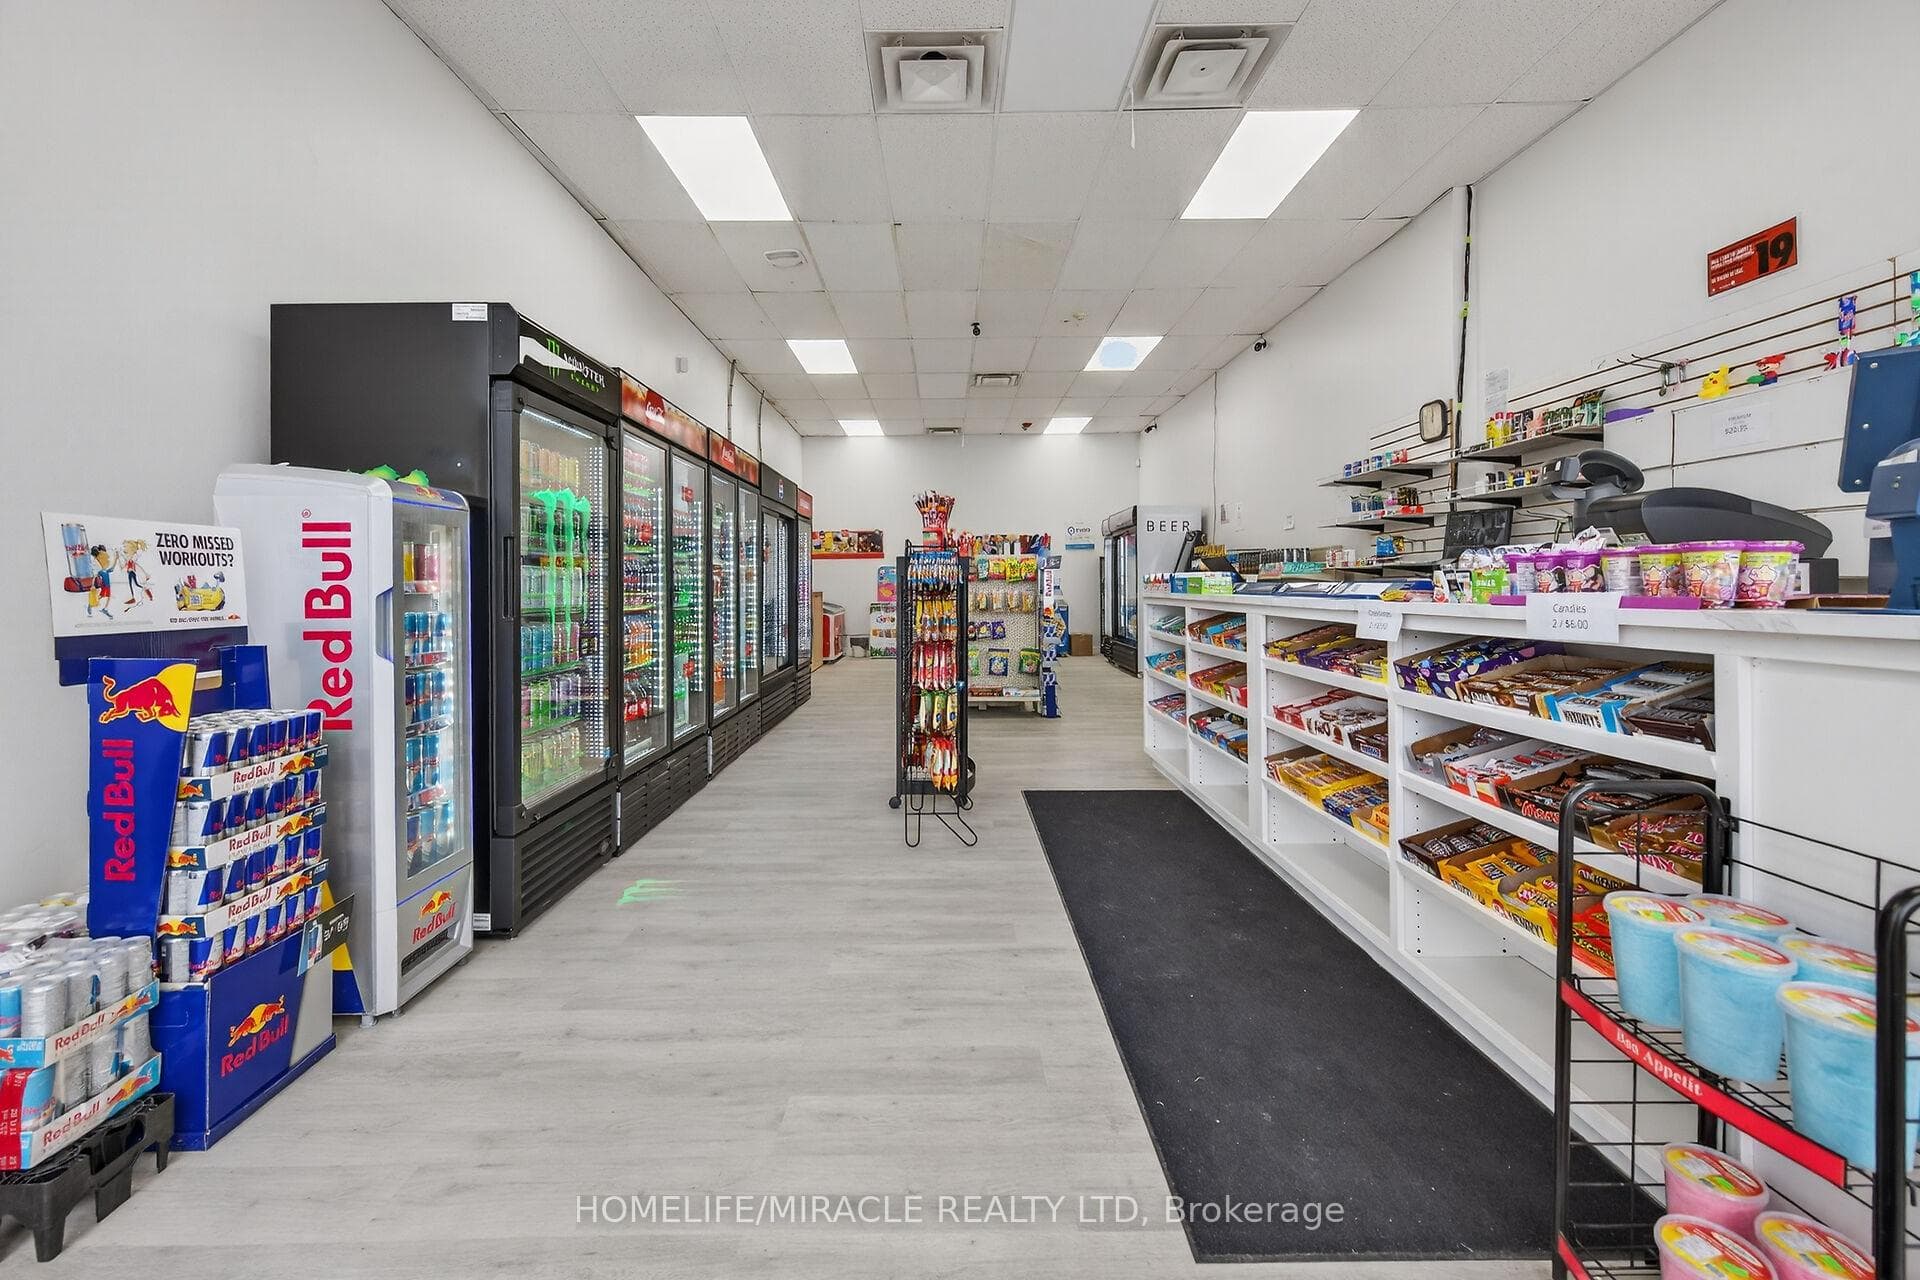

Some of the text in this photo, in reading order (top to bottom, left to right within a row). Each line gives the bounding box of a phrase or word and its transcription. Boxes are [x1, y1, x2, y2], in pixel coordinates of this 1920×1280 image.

[1756, 232, 1794, 275] 19
[155, 532, 234, 551] ZERO MISSED
[1146, 520, 1190, 532] BEER
[158, 550, 234, 567] WORKOUTS?
[301, 522, 353, 730] Red Bull
[1552, 603, 1587, 614] Candies
[233, 769, 254, 784] Red
[102, 738, 136, 882] Red Bull
[229, 834, 251, 852] Red
[228, 886, 272, 918] Red Bull
[412, 902, 457, 944] Red Bull
[54, 1026, 81, 1051] Red
[81, 1013, 106, 1036] Bull
[220, 1014, 289, 1078] Red Bull
[42, 1100, 100, 1147] Red Bull
